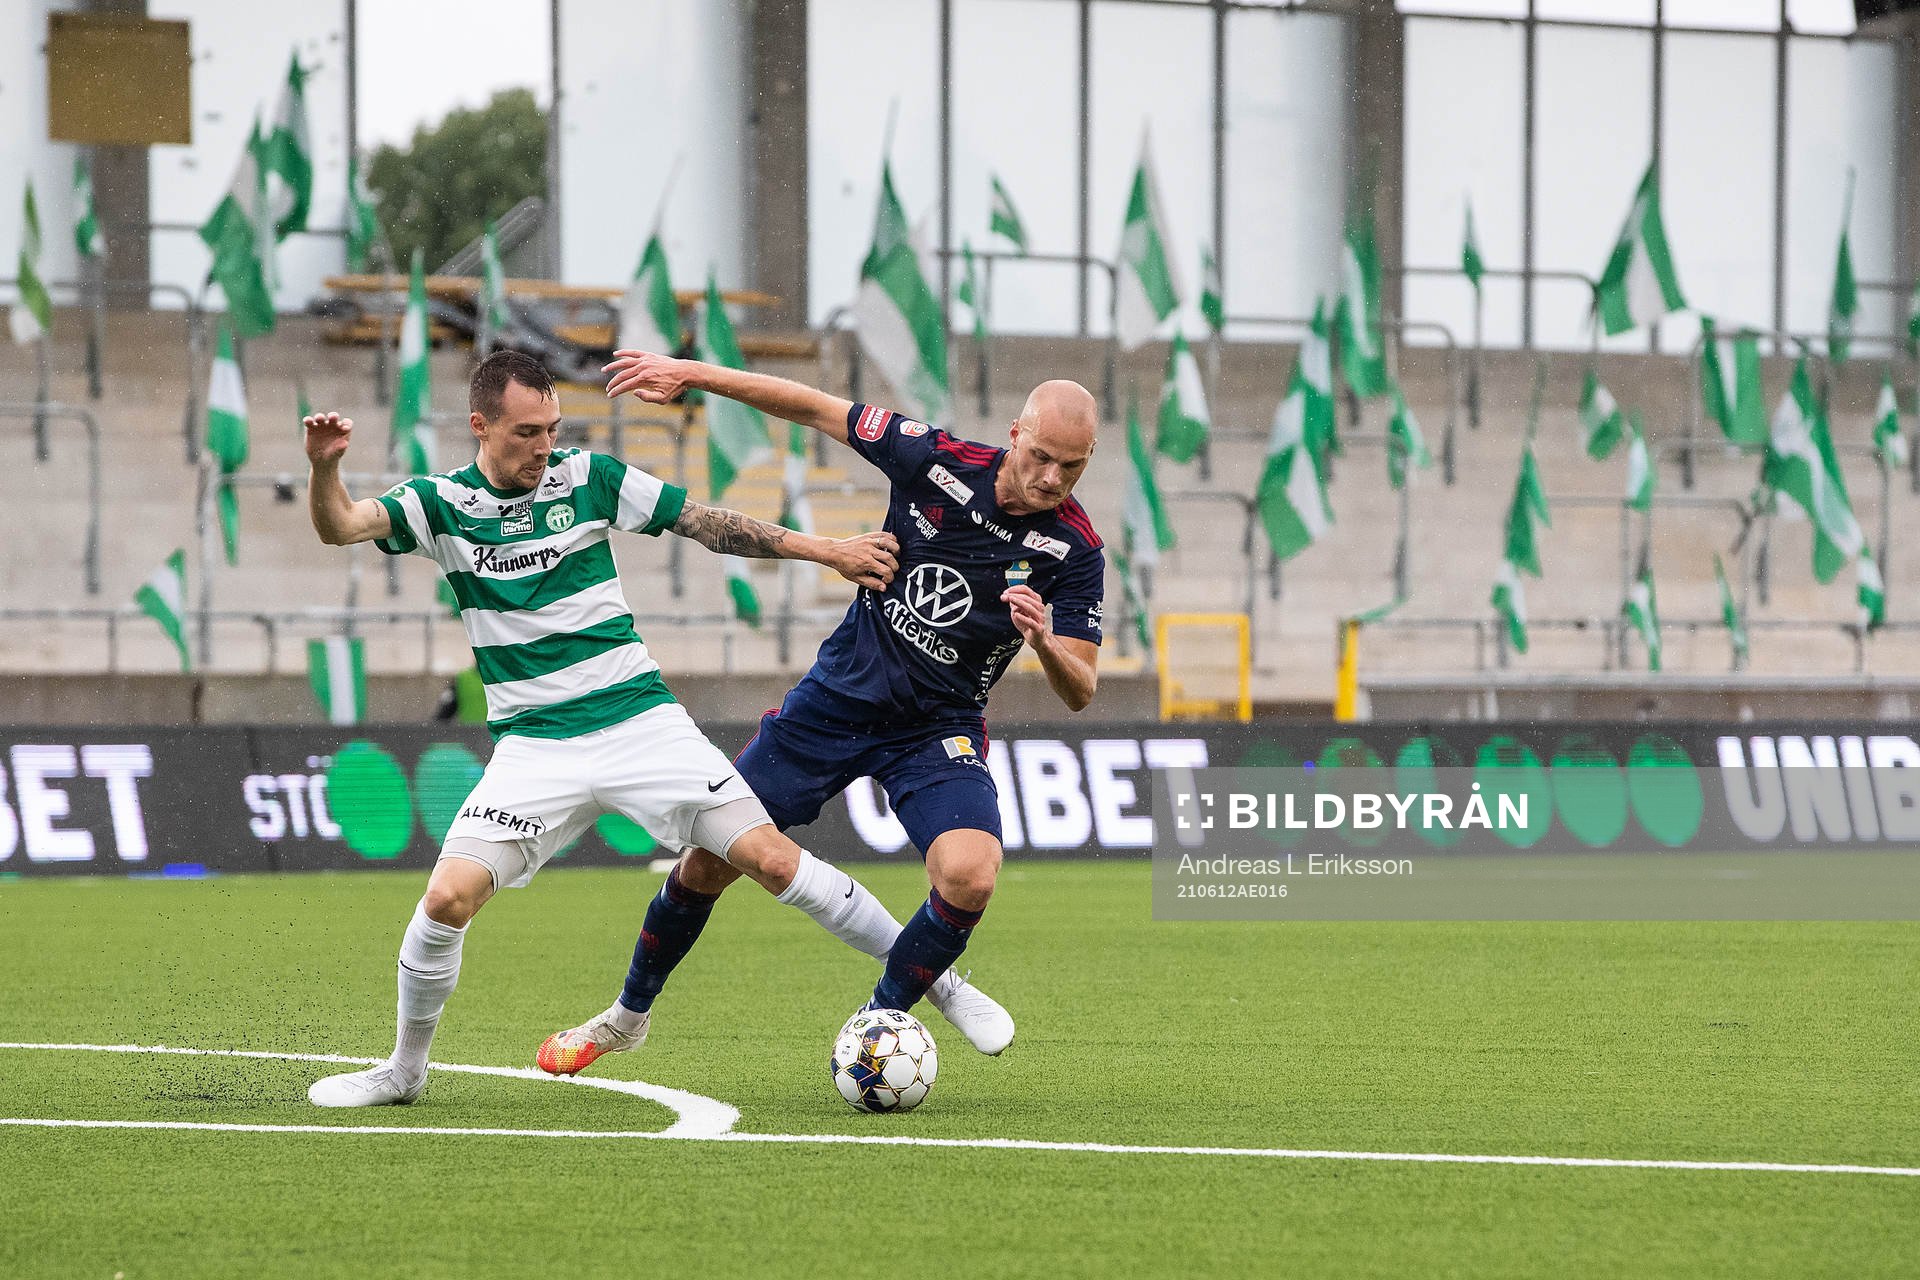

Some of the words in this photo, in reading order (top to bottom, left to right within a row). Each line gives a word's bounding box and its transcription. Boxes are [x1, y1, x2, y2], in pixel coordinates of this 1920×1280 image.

[915, 519, 933, 540] SPORT
[918, 514, 939, 537] INTER
[985, 520, 1013, 543] VISMA
[473, 546, 570, 574] Kinnarps
[884, 598, 959, 665] Atteviks
[0, 744, 154, 862] ET
[460, 805, 542, 836] ALKEMIT
